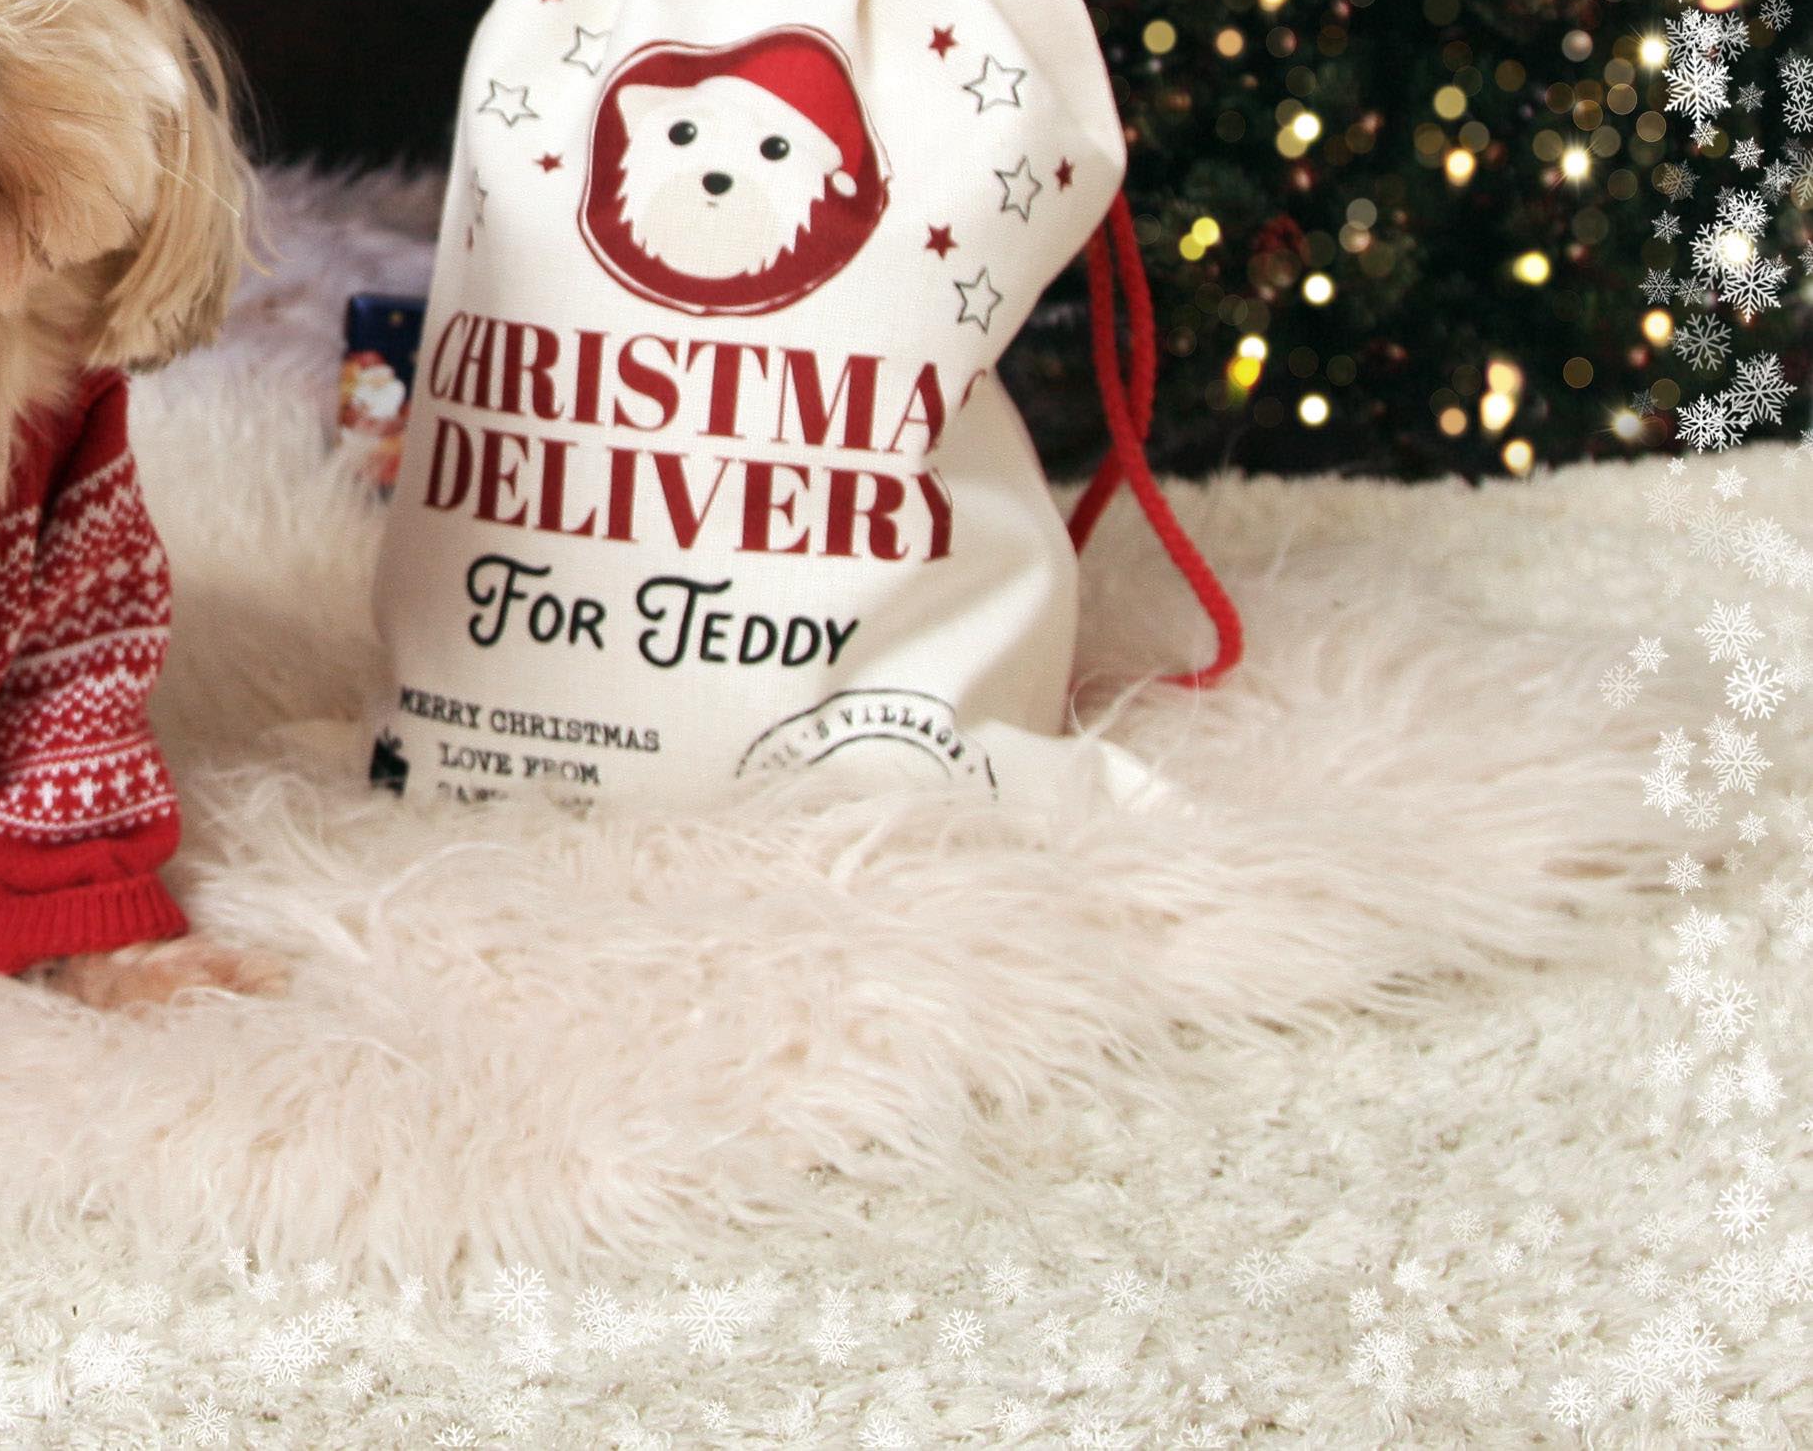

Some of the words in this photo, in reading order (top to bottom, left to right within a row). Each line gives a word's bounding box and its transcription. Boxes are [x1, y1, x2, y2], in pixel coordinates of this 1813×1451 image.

[429, 310, 986, 455] CHRISTMA
[399, 685, 482, 730] MERRY
[489, 709, 662, 753] CHRISTMAS
[439, 741, 513, 777] LOVE
